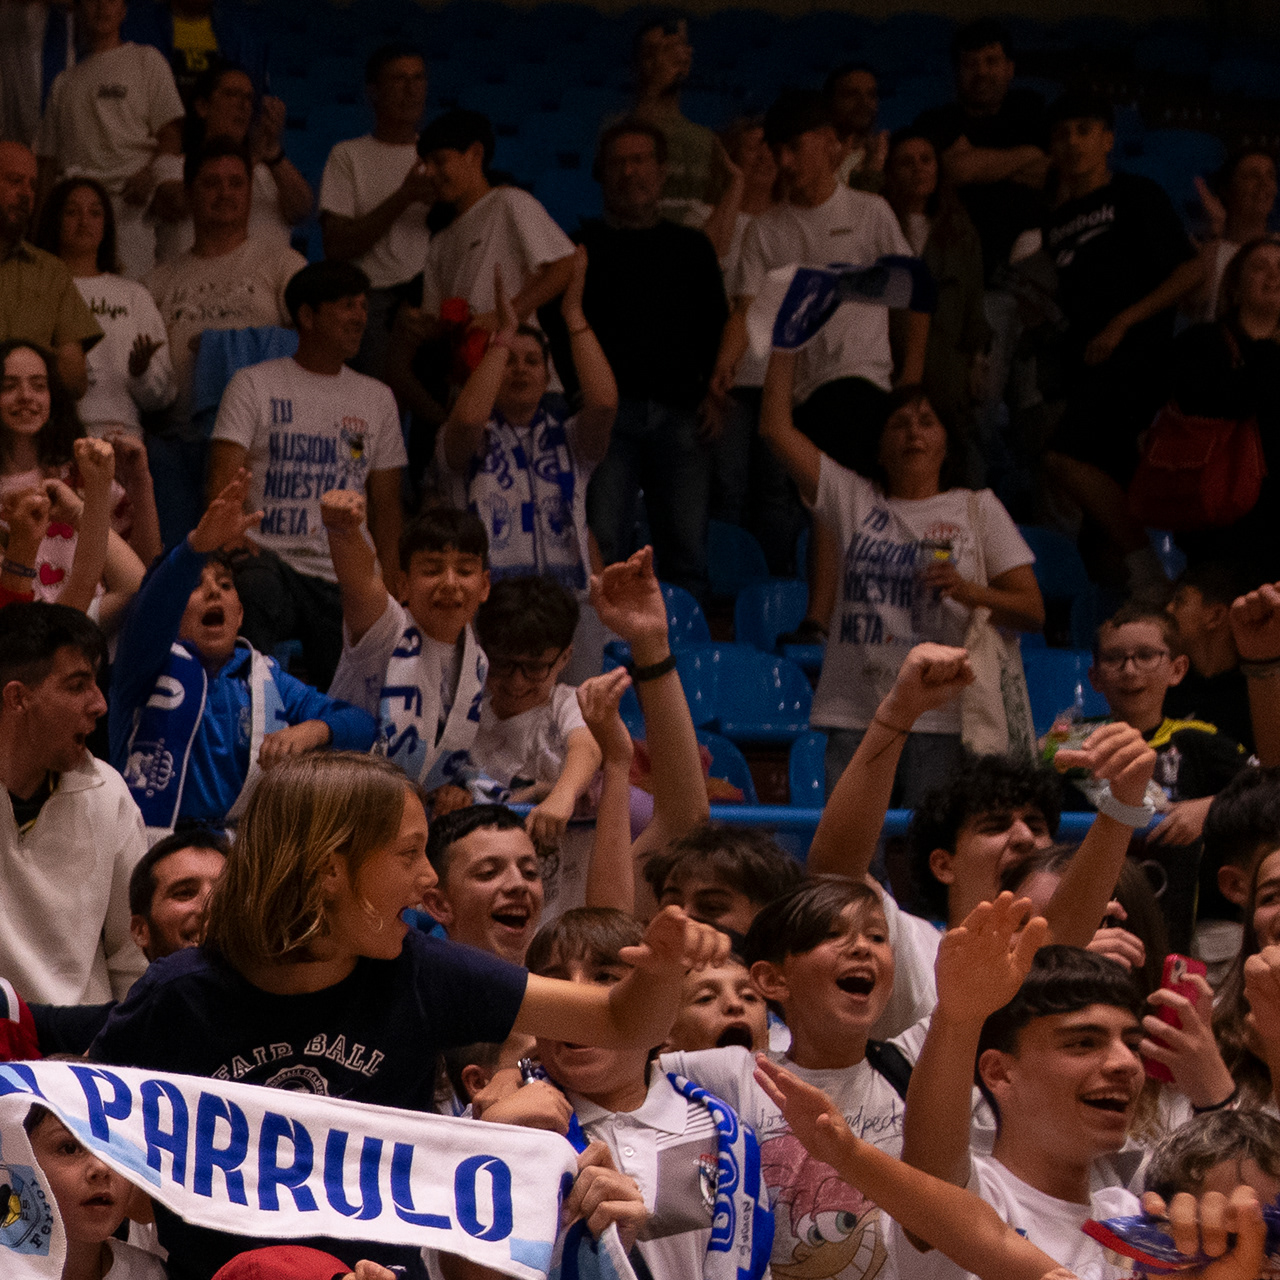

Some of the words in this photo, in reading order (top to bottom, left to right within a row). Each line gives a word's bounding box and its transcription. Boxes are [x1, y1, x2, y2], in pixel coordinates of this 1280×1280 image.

[270, 398, 292, 424] TU
[260, 507, 308, 536] META
[841, 613, 884, 645] META
[303, 1033, 386, 1078] BALL
[69, 1064, 514, 1243] PARRULO
